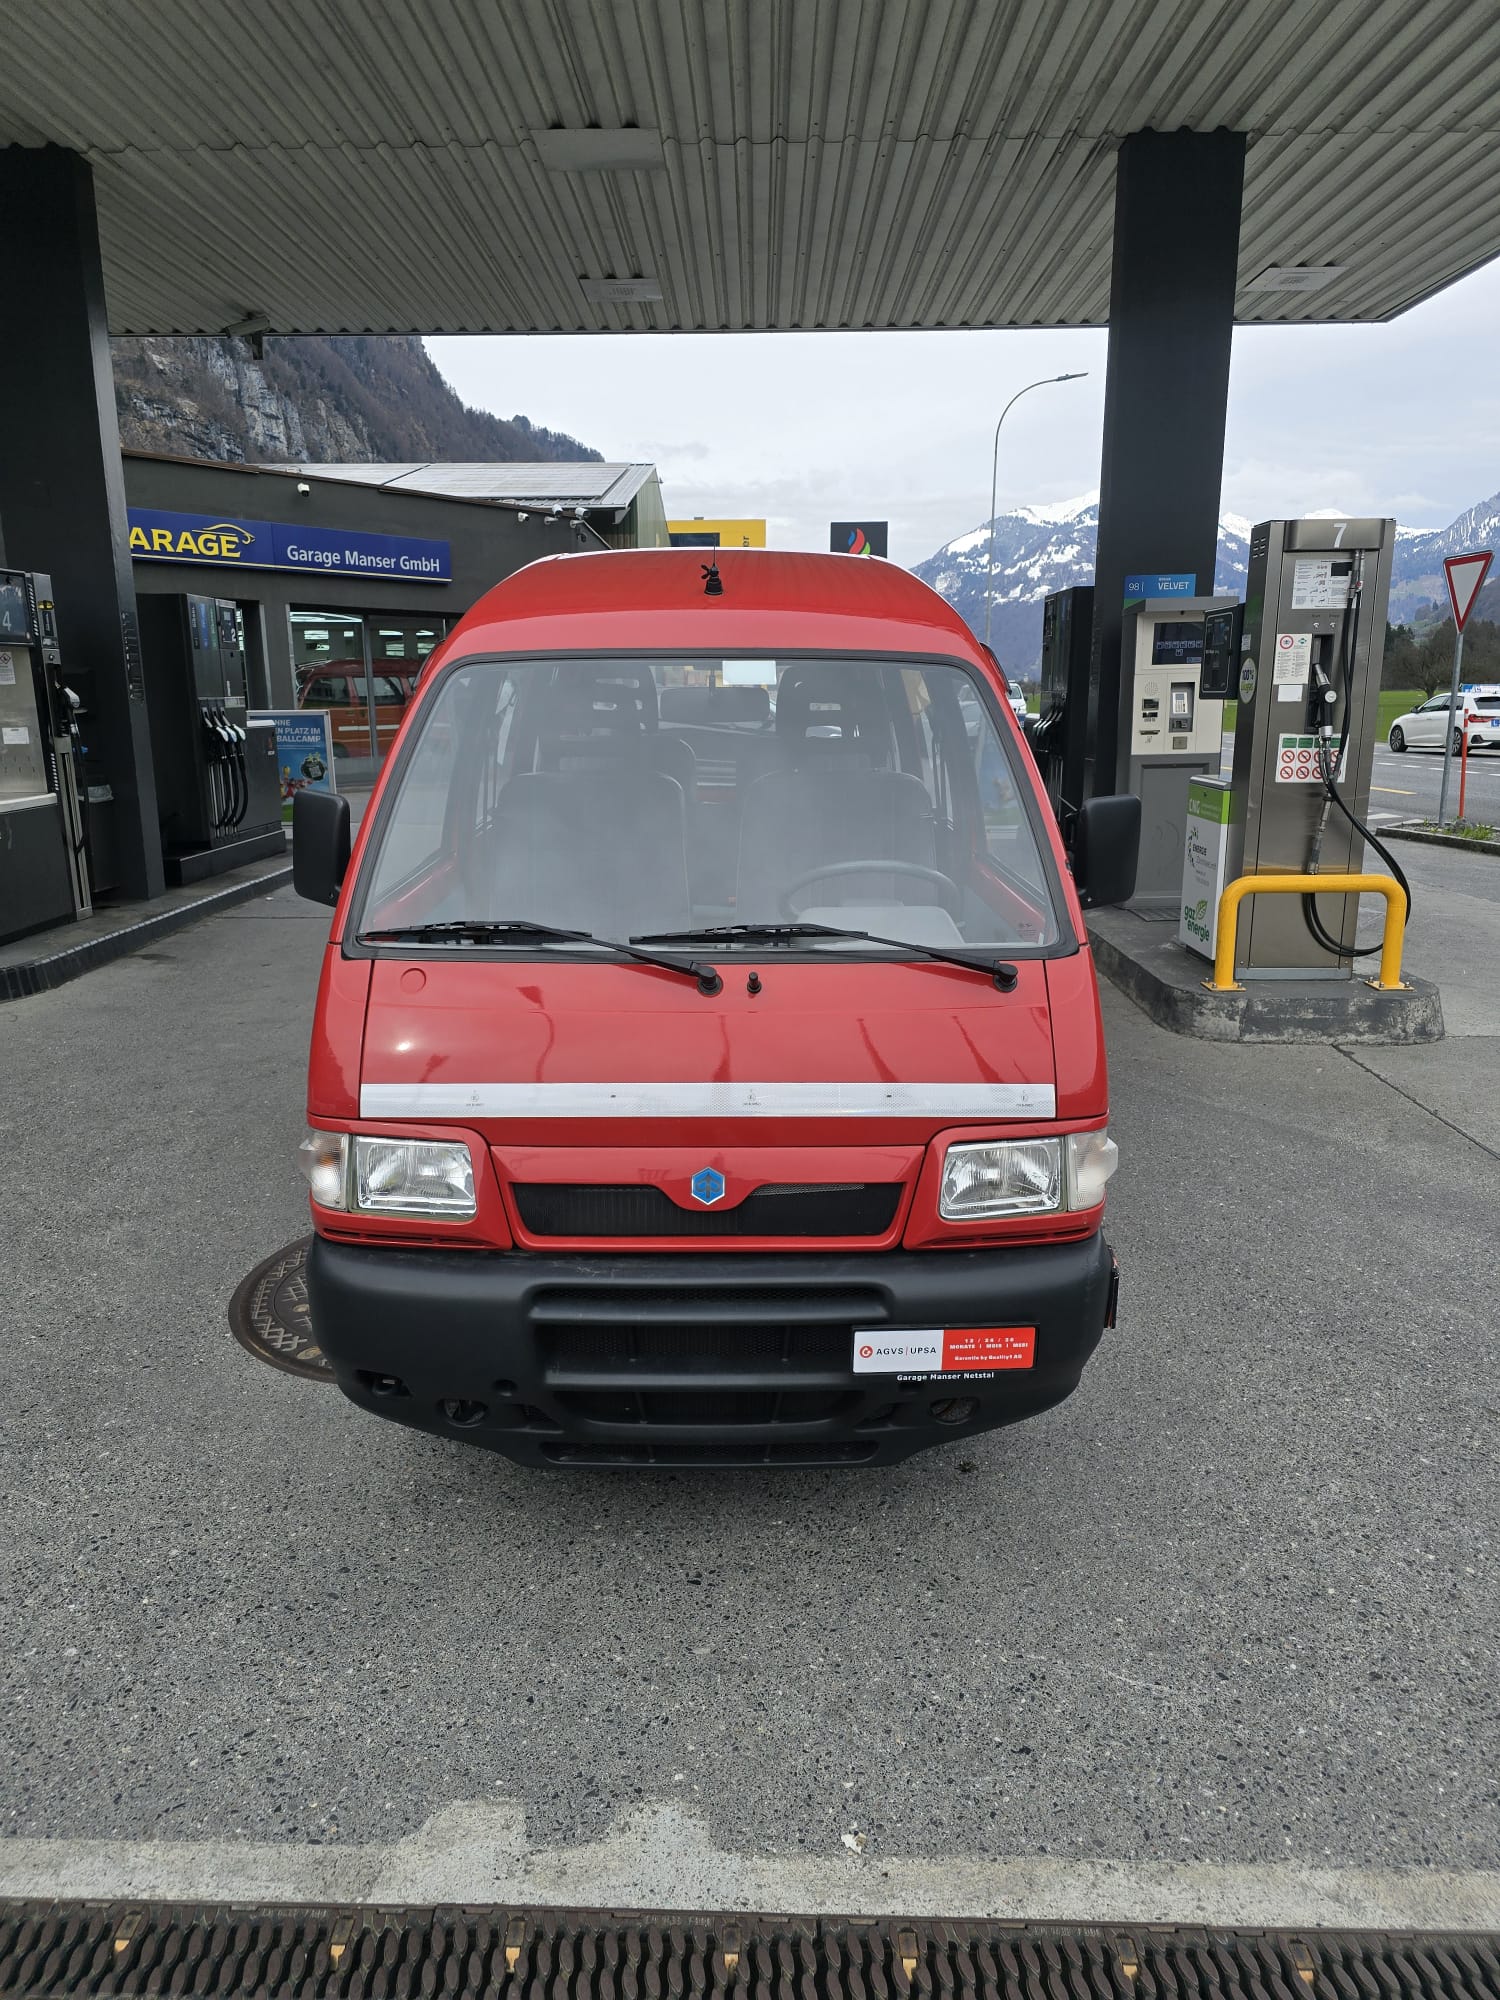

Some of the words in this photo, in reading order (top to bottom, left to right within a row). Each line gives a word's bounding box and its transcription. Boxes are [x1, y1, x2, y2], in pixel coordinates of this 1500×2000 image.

[1333, 522, 1347, 548] 7
[286, 545, 341, 567] Garage
[344, 550, 396, 569] Manser
[399, 555, 440, 573] GmbH
[1128, 582, 1140, 591] 98
[1157, 581, 1190, 591] VELVET
[2, 610, 12, 632] 4
[230, 628, 237, 642] 2
[284, 727, 310, 735] PLATZ
[310, 727, 321, 735] IM
[1183, 904, 1195, 921] gaz
[1187, 918, 1210, 942] energie
[876, 1347, 904, 1356] AGVS
[910, 1346, 937, 1355] UPSA
[896, 1374, 928, 1382] Garage
[963, 1371, 995, 1379] Netstal
